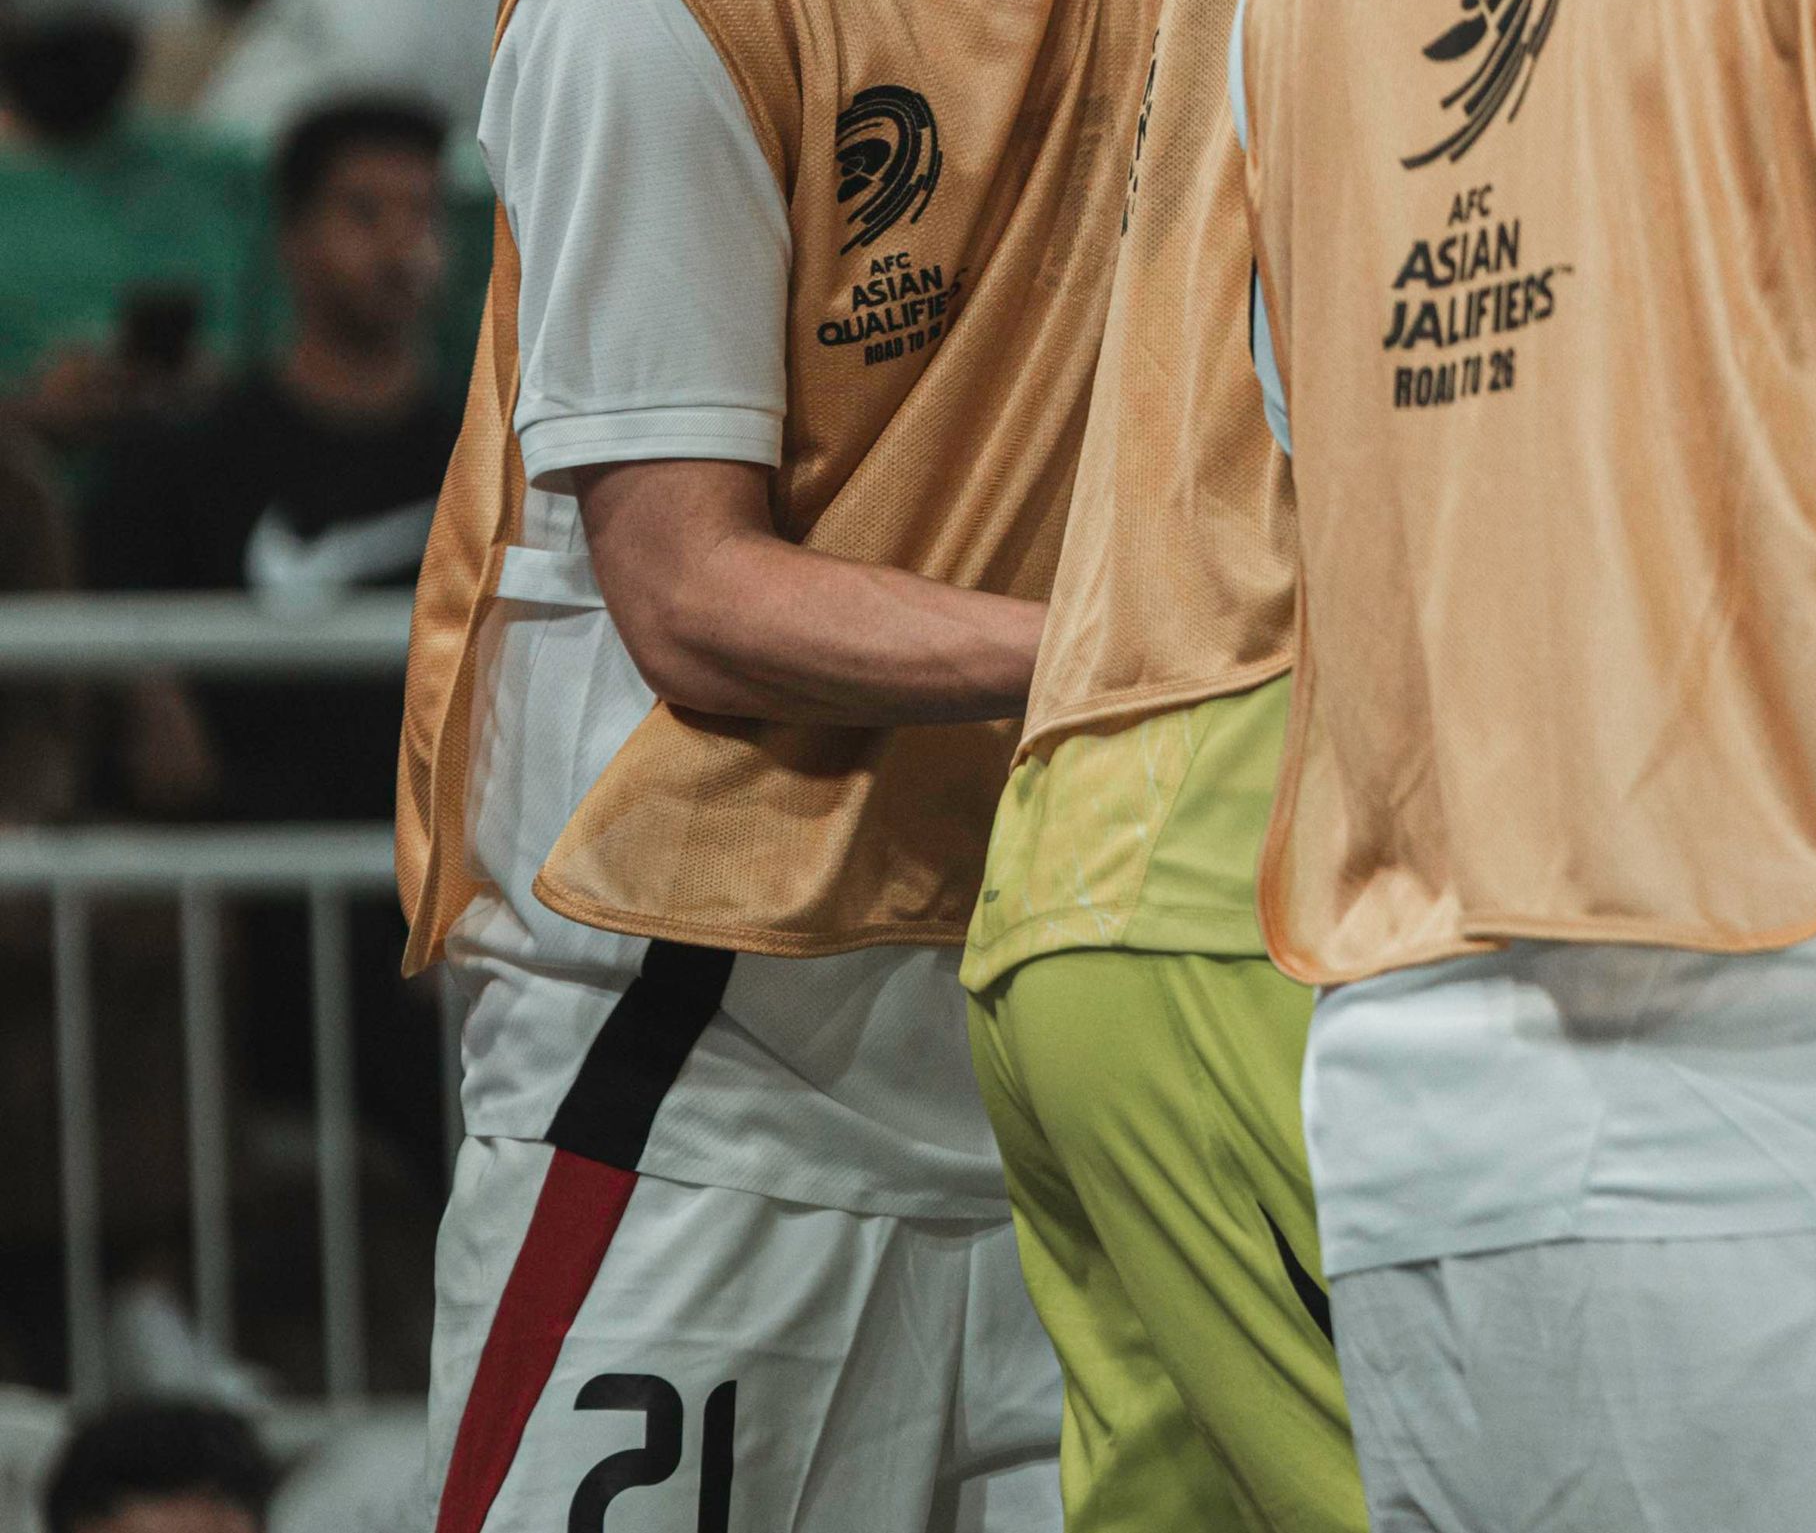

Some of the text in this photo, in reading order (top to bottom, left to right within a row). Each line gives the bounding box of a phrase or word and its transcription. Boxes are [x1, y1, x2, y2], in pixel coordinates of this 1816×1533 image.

[1447, 183, 1492, 227] AFC
[870, 252, 911, 276] AFC
[1392, 219, 1520, 290] ASIAN
[852, 265, 943, 313] ASIAN
[864, 336, 904, 366] ROAD
[908, 331, 925, 353] TO
[1488, 347, 1515, 391] 26
[568, 1373, 737, 1533] 21
